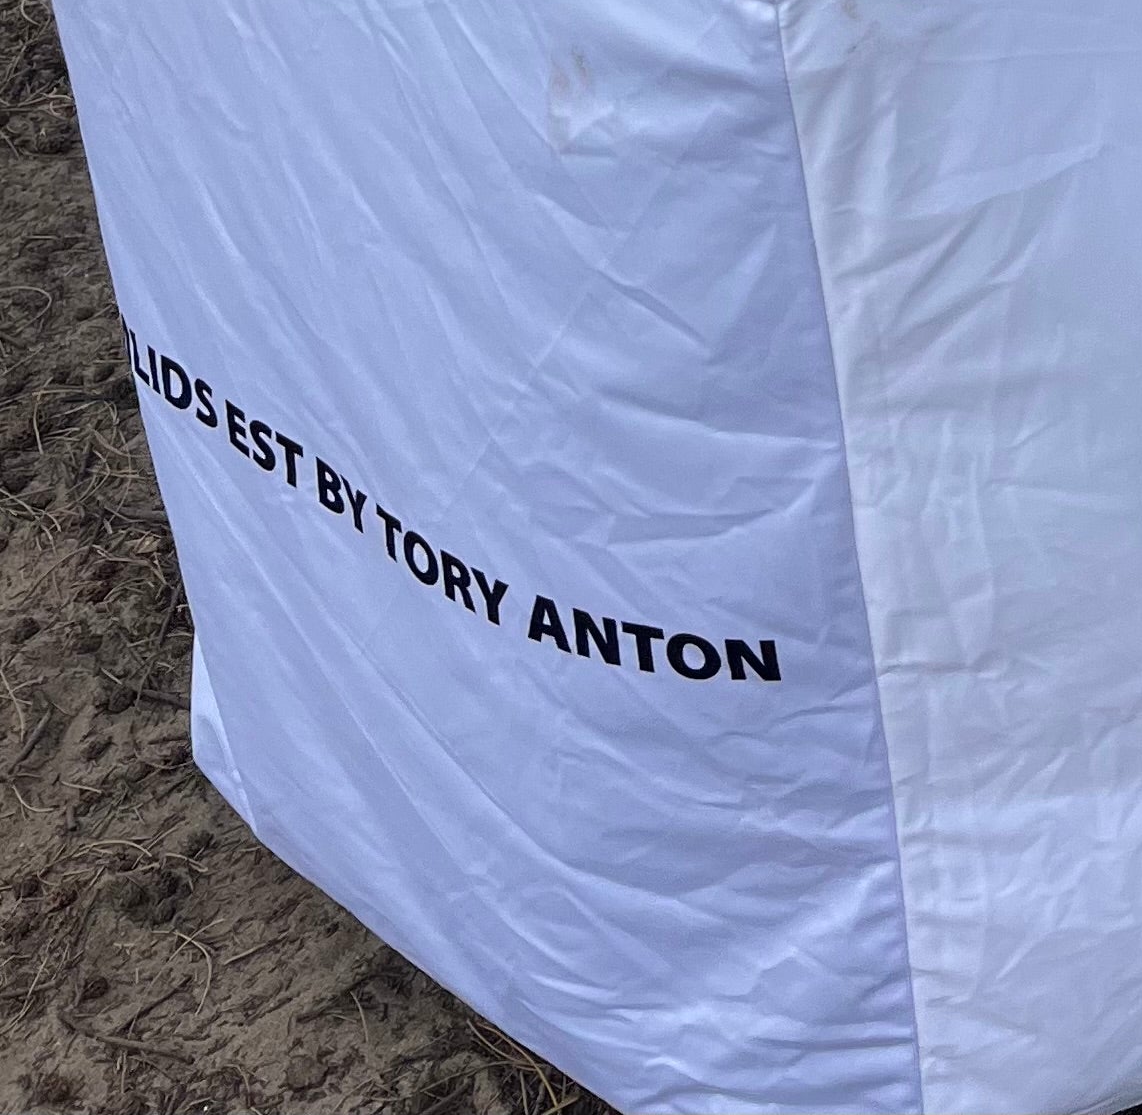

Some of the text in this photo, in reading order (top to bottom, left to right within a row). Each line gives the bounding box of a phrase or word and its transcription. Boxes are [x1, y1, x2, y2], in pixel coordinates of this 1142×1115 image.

[121, 312, 783, 682] LIDS EST BY TORY ANTON
